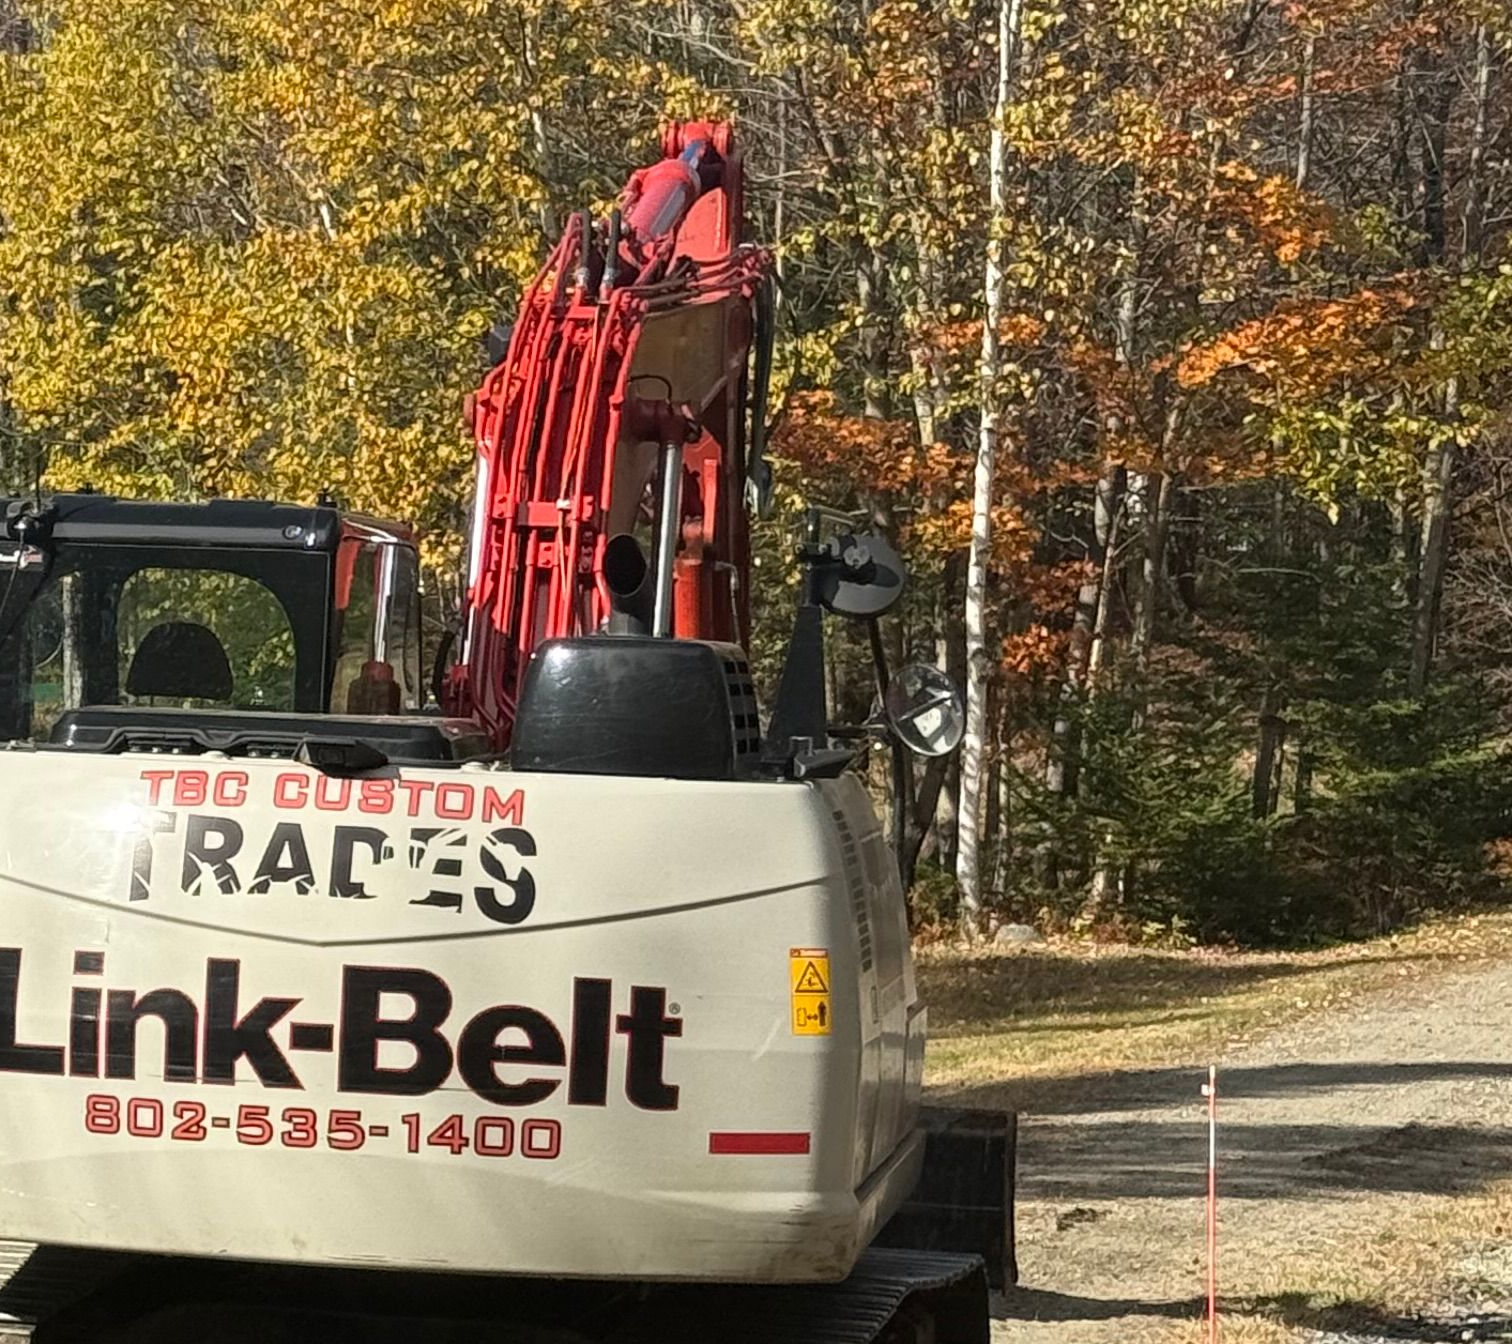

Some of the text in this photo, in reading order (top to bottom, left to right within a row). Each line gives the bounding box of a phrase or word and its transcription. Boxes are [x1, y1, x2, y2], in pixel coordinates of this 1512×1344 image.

[141, 769, 525, 826] TBC CUSTOM
[85, 1094, 563, 1160] 802-535-1400
